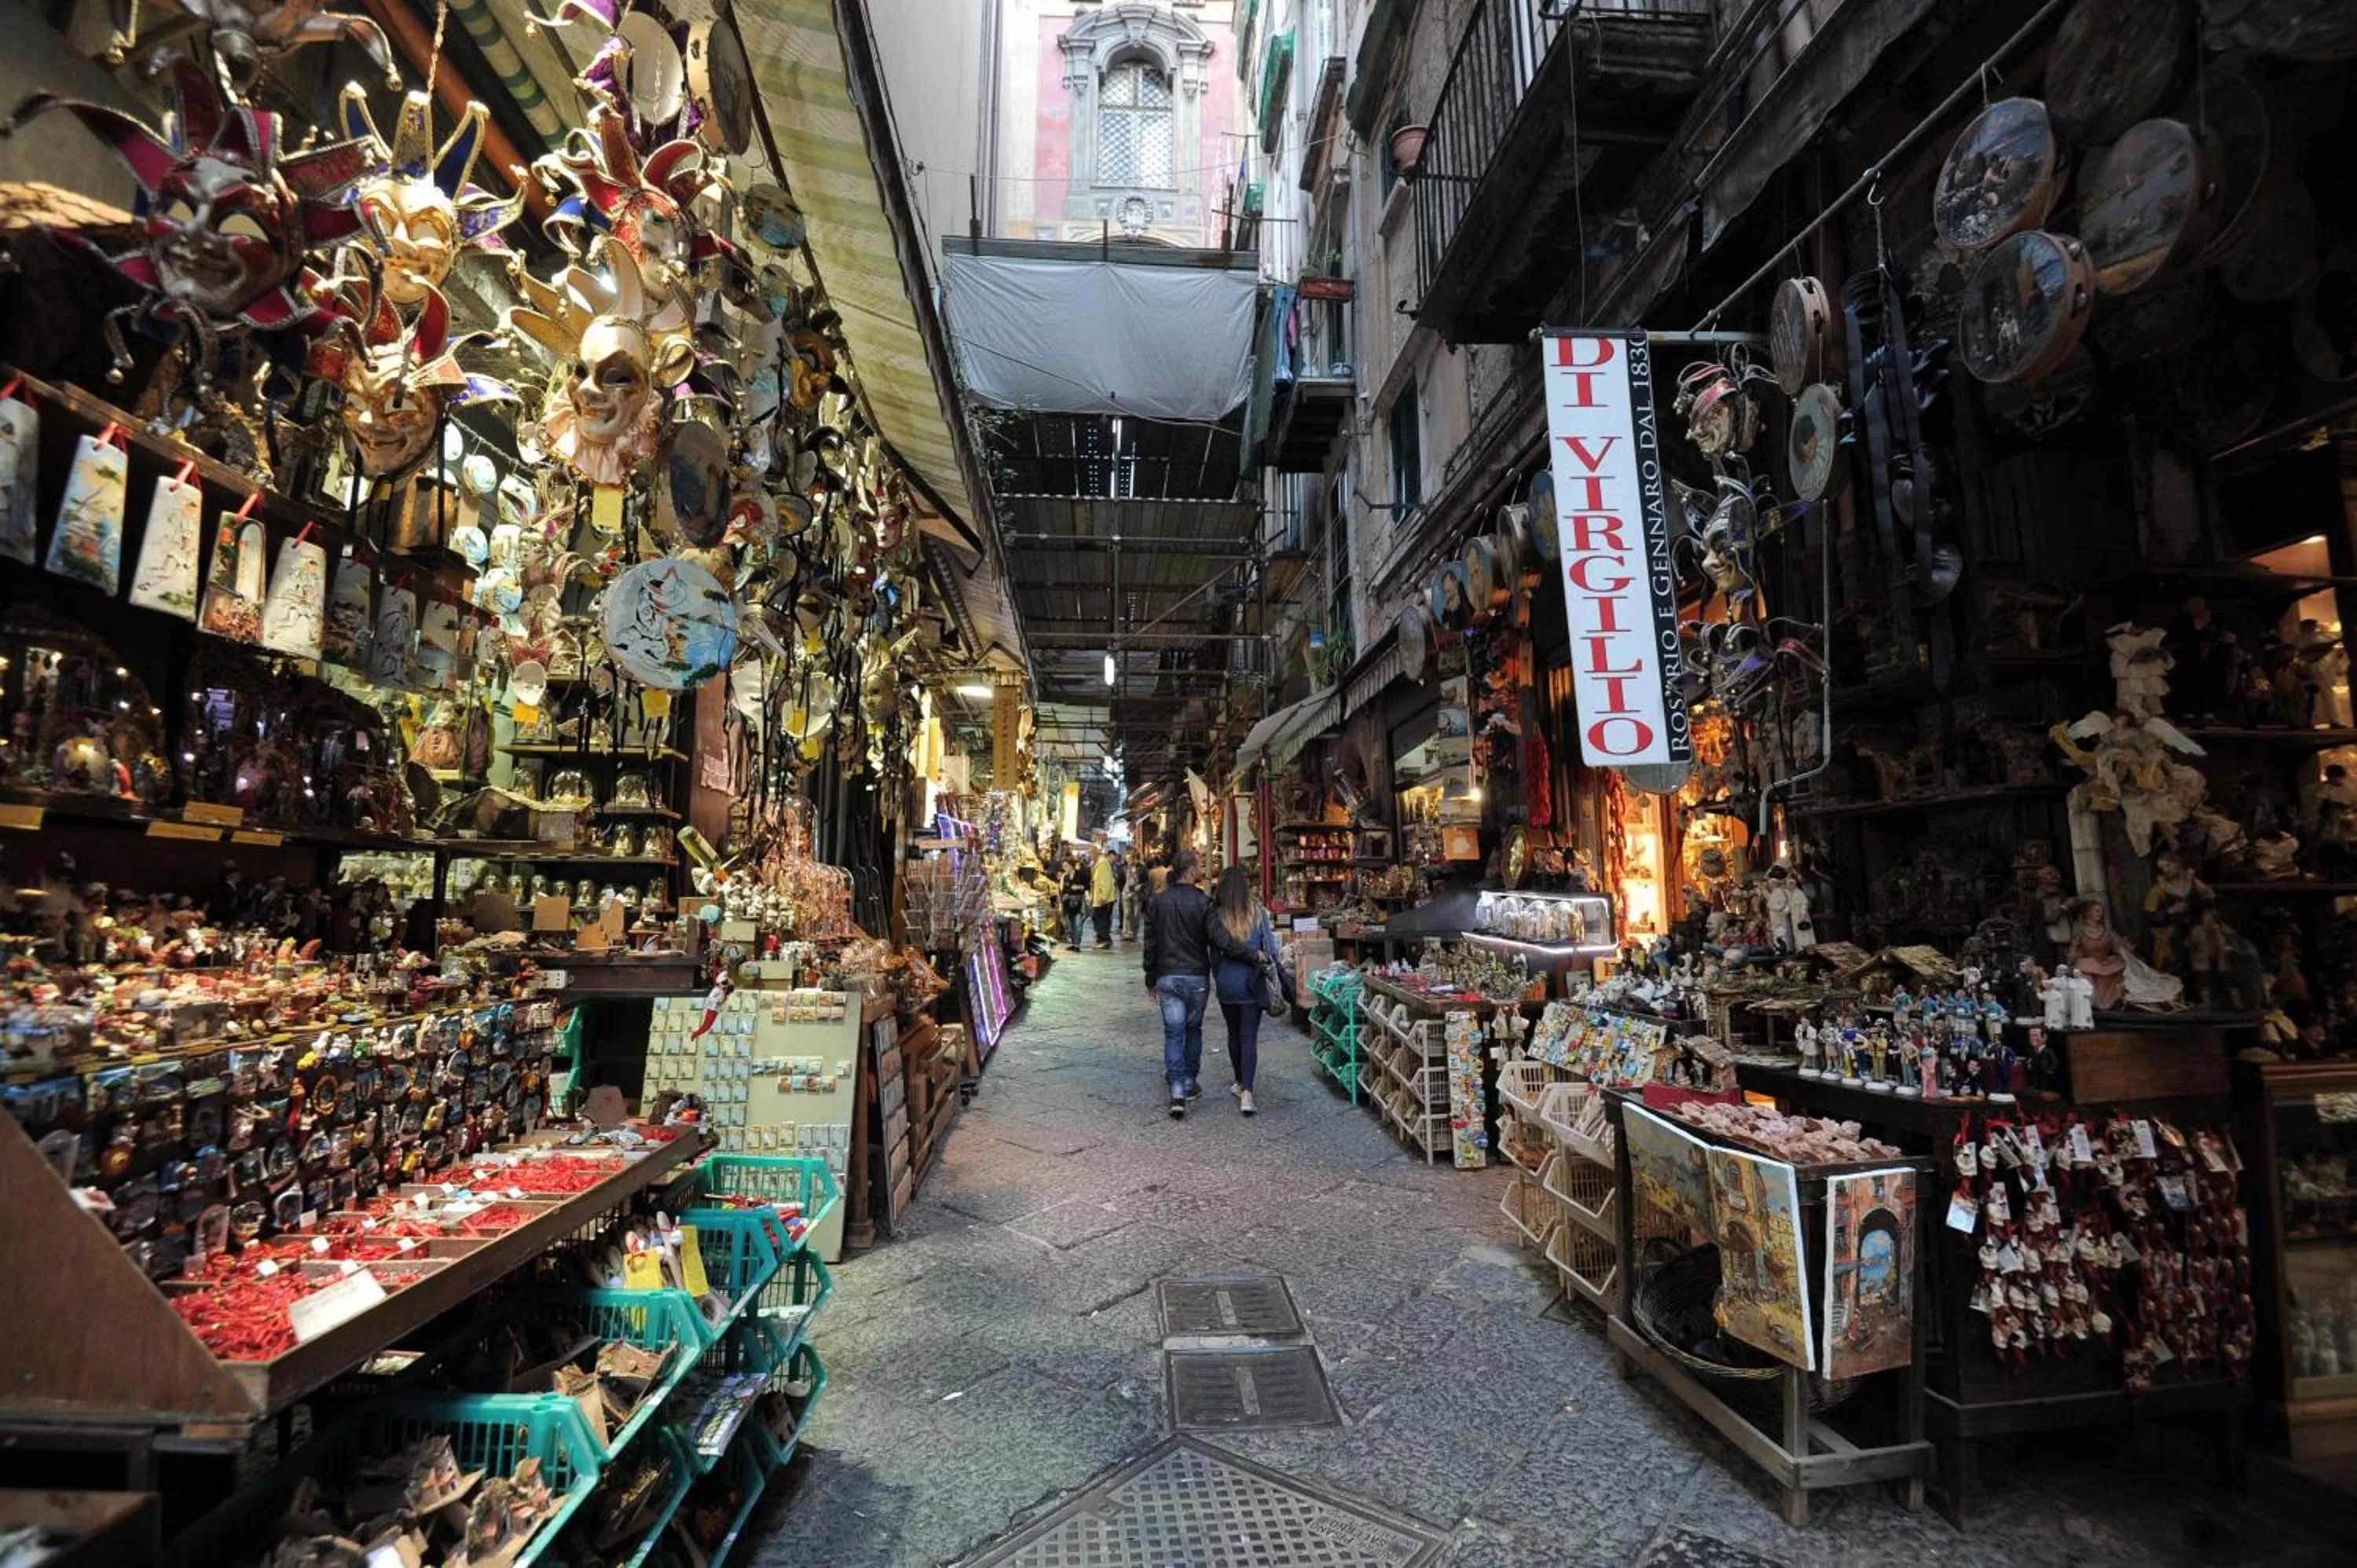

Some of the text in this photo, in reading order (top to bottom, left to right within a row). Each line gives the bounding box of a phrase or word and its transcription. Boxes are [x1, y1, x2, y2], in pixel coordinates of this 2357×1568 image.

[1637, 401, 1656, 449] DAL
[1550, 336, 1654, 756] DI VIRGILIO
[1642, 460, 1671, 596] GENNARO
[1659, 606, 1674, 619] E
